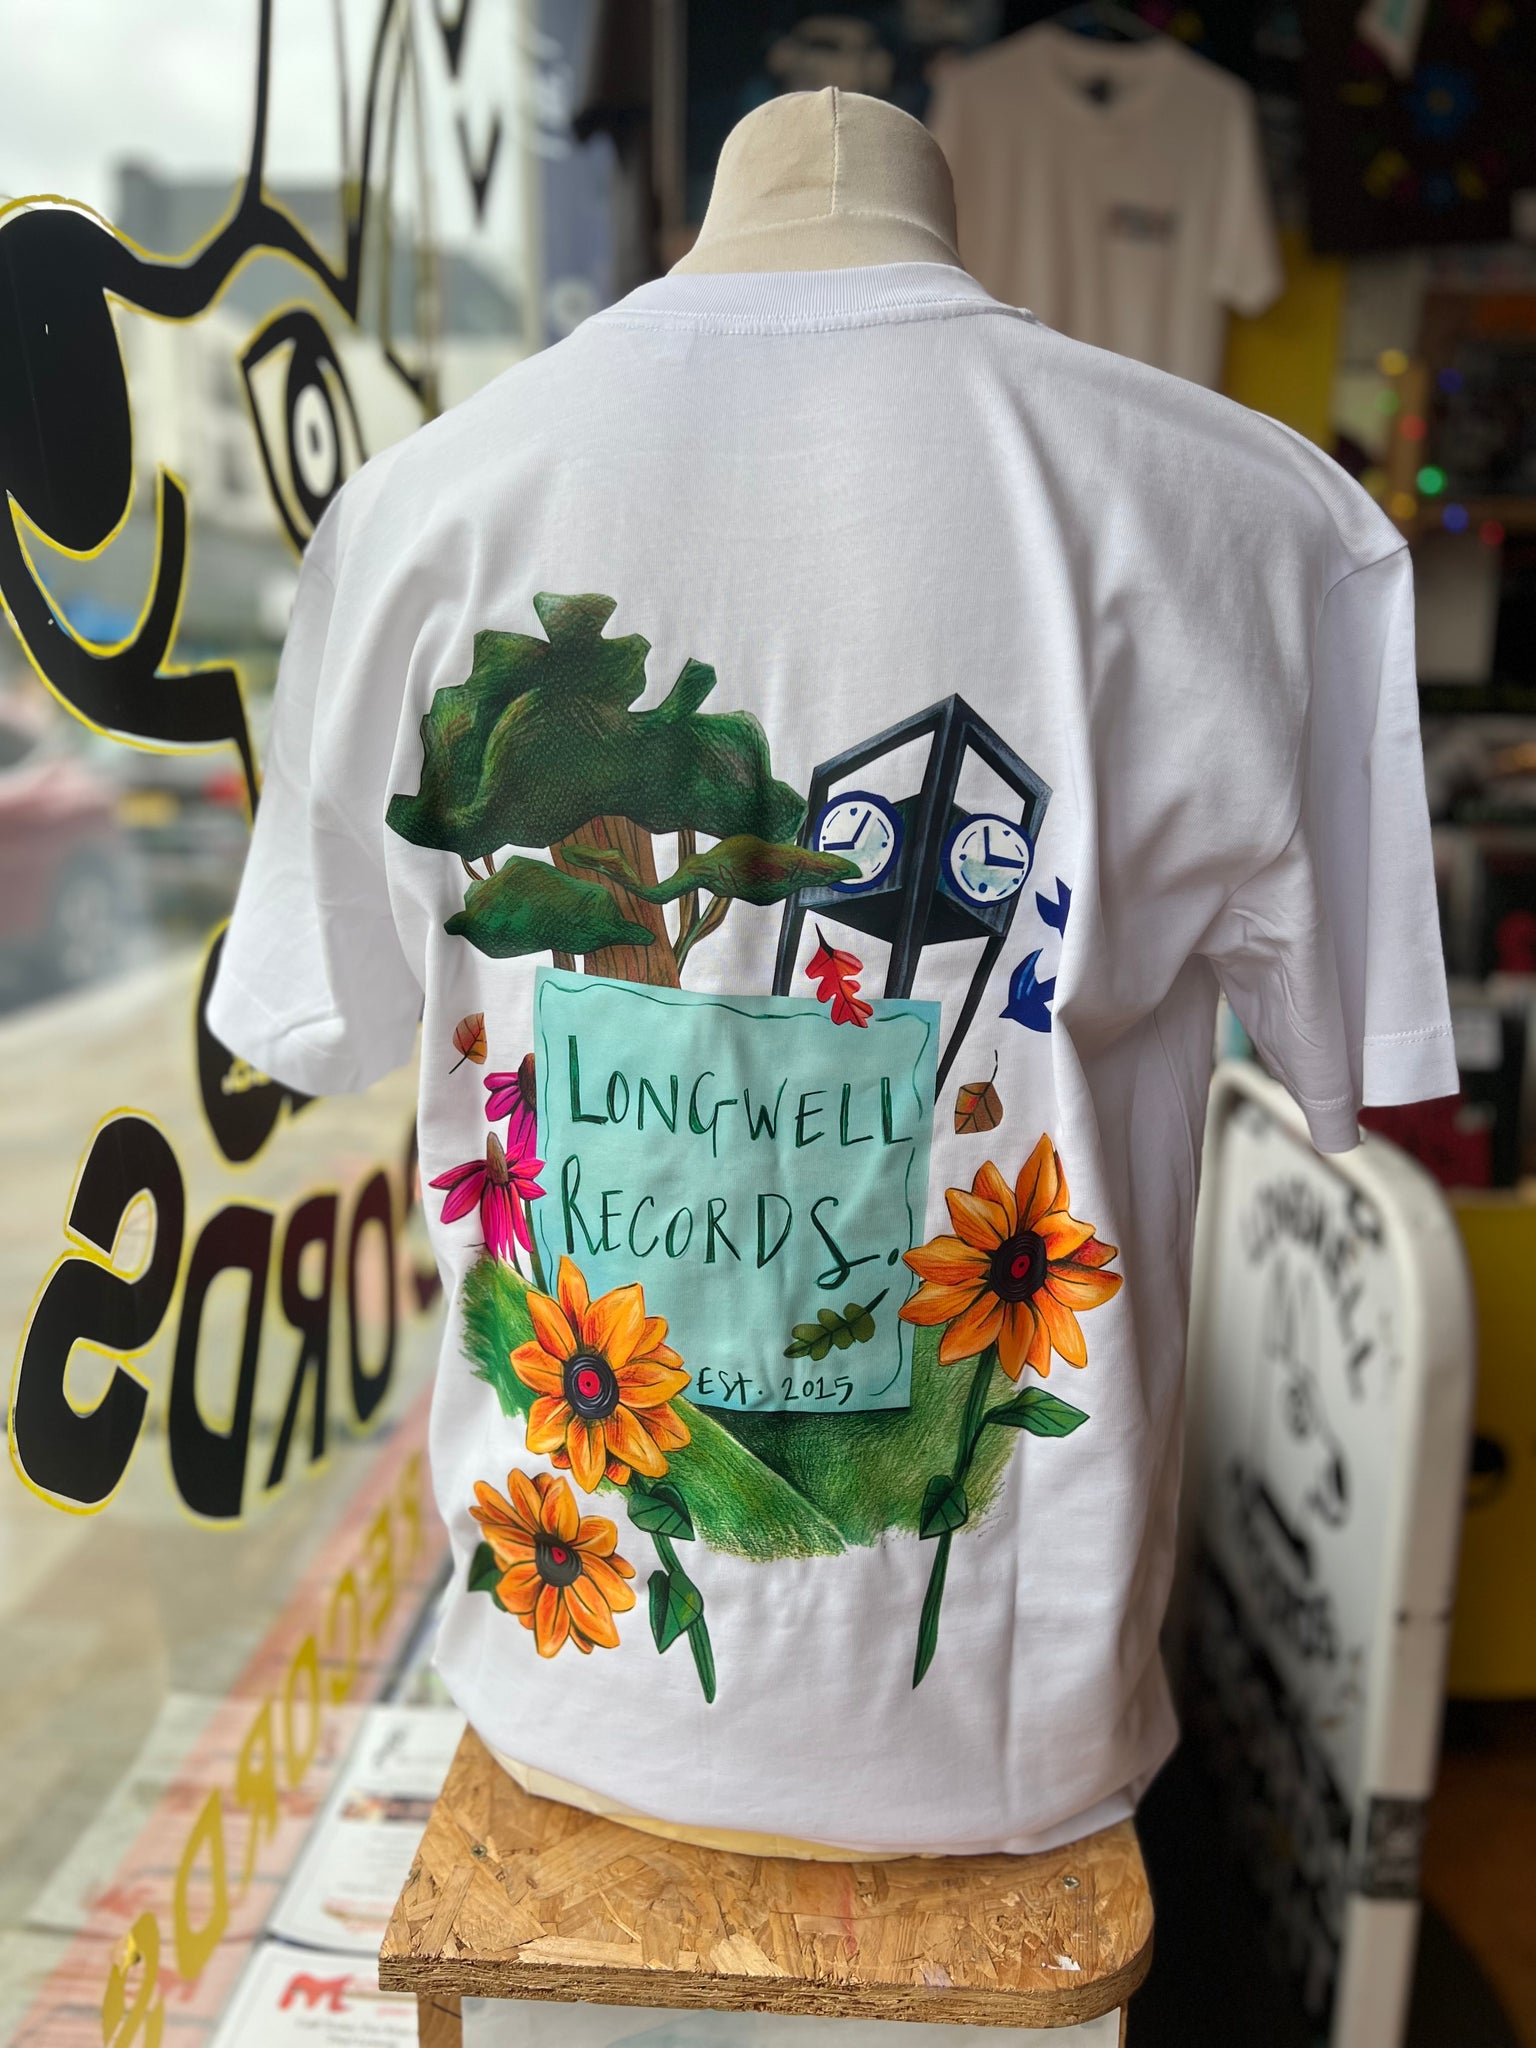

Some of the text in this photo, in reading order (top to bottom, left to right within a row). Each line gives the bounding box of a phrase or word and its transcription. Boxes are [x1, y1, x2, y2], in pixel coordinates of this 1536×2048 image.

[567, 1034, 913, 1157] LONGWELL
[561, 1154, 898, 1290] RECORDS.
[782, 1375, 854, 1406] 2015
